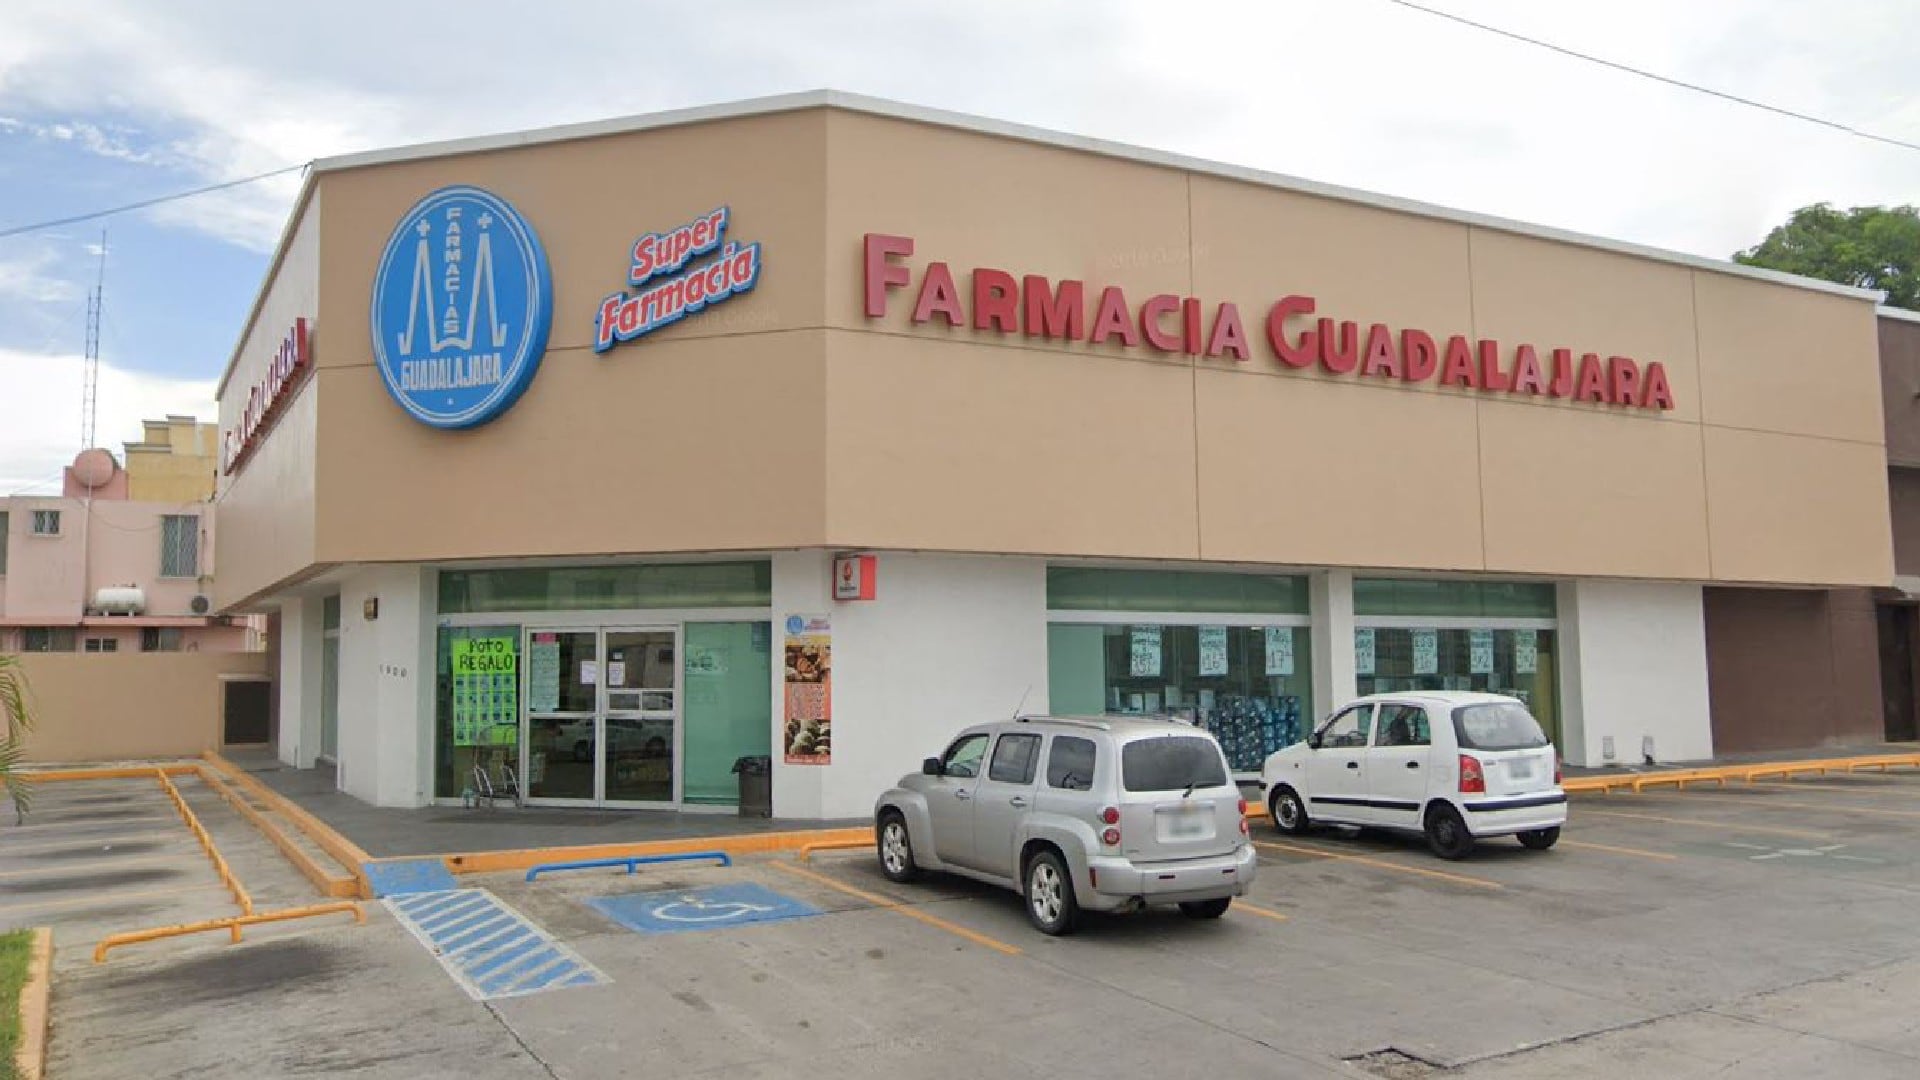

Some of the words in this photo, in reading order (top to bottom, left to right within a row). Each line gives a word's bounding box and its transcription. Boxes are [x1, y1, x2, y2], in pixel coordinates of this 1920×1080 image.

[444, 207, 463, 334] FARMACIAS
[630, 207, 724, 281] Super
[598, 246, 754, 343] Farmacia
[863, 232, 1250, 362] FARMACIA
[1266, 293, 1676, 411] GUADALAJARA
[401, 352, 502, 392] GUADALAJARA
[459, 653, 513, 671] REGALO
